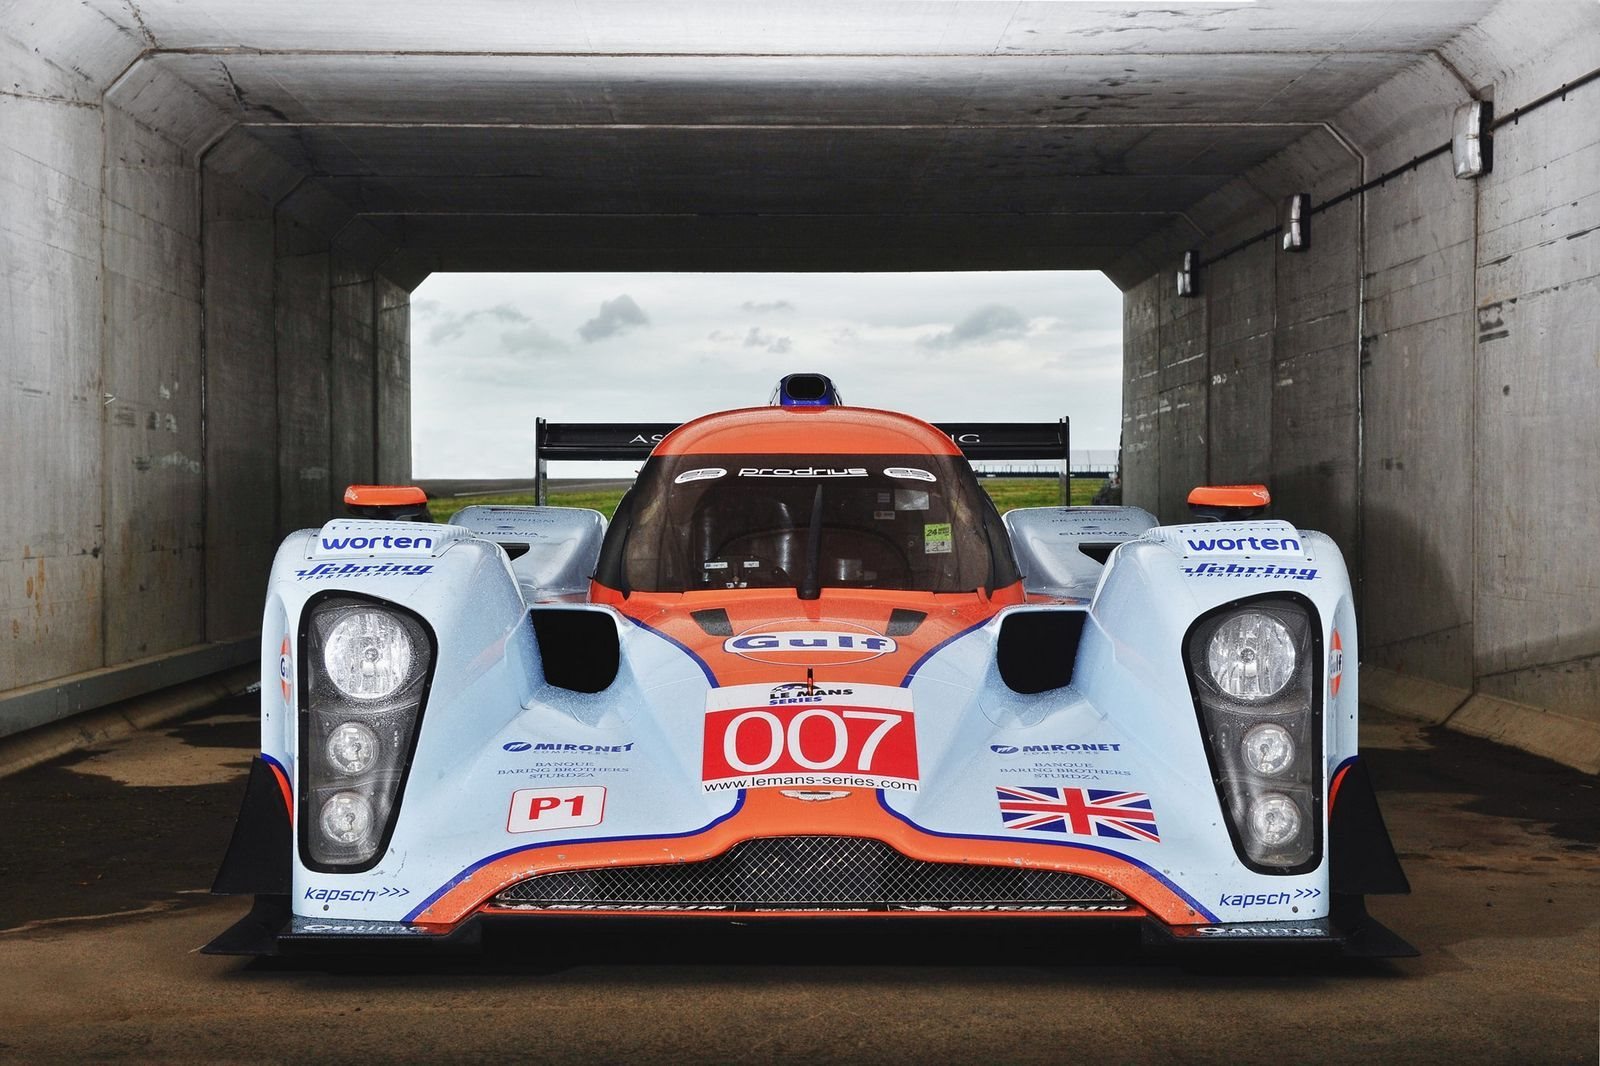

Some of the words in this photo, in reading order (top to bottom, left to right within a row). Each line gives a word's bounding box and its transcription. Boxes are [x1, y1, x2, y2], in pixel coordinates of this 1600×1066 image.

[322, 535, 432, 550] worten
[1187, 536, 1300, 551] worten
[294, 562, 434, 577] Sebring
[1180, 563, 1321, 581] Sebring
[732, 635, 888, 650] Gulf
[768, 696, 823, 706] SERIES
[769, 692, 790, 700] LE
[797, 688, 854, 697] MANS
[534, 742, 634, 753] MIRONET
[723, 708, 903, 773] 007
[1022, 743, 1121, 752] MIRONET
[497, 767, 551, 775] BARING
[528, 772, 595, 780] STURDZA
[1033, 772, 1100, 781] STURDZA
[1056, 767, 1132, 776] BROTHERS
[704, 774, 918, 793] www.lemans-series.com
[529, 795, 585, 820] P1
[304, 886, 376, 903] kapsch
[1219, 891, 1291, 909] kapsch
